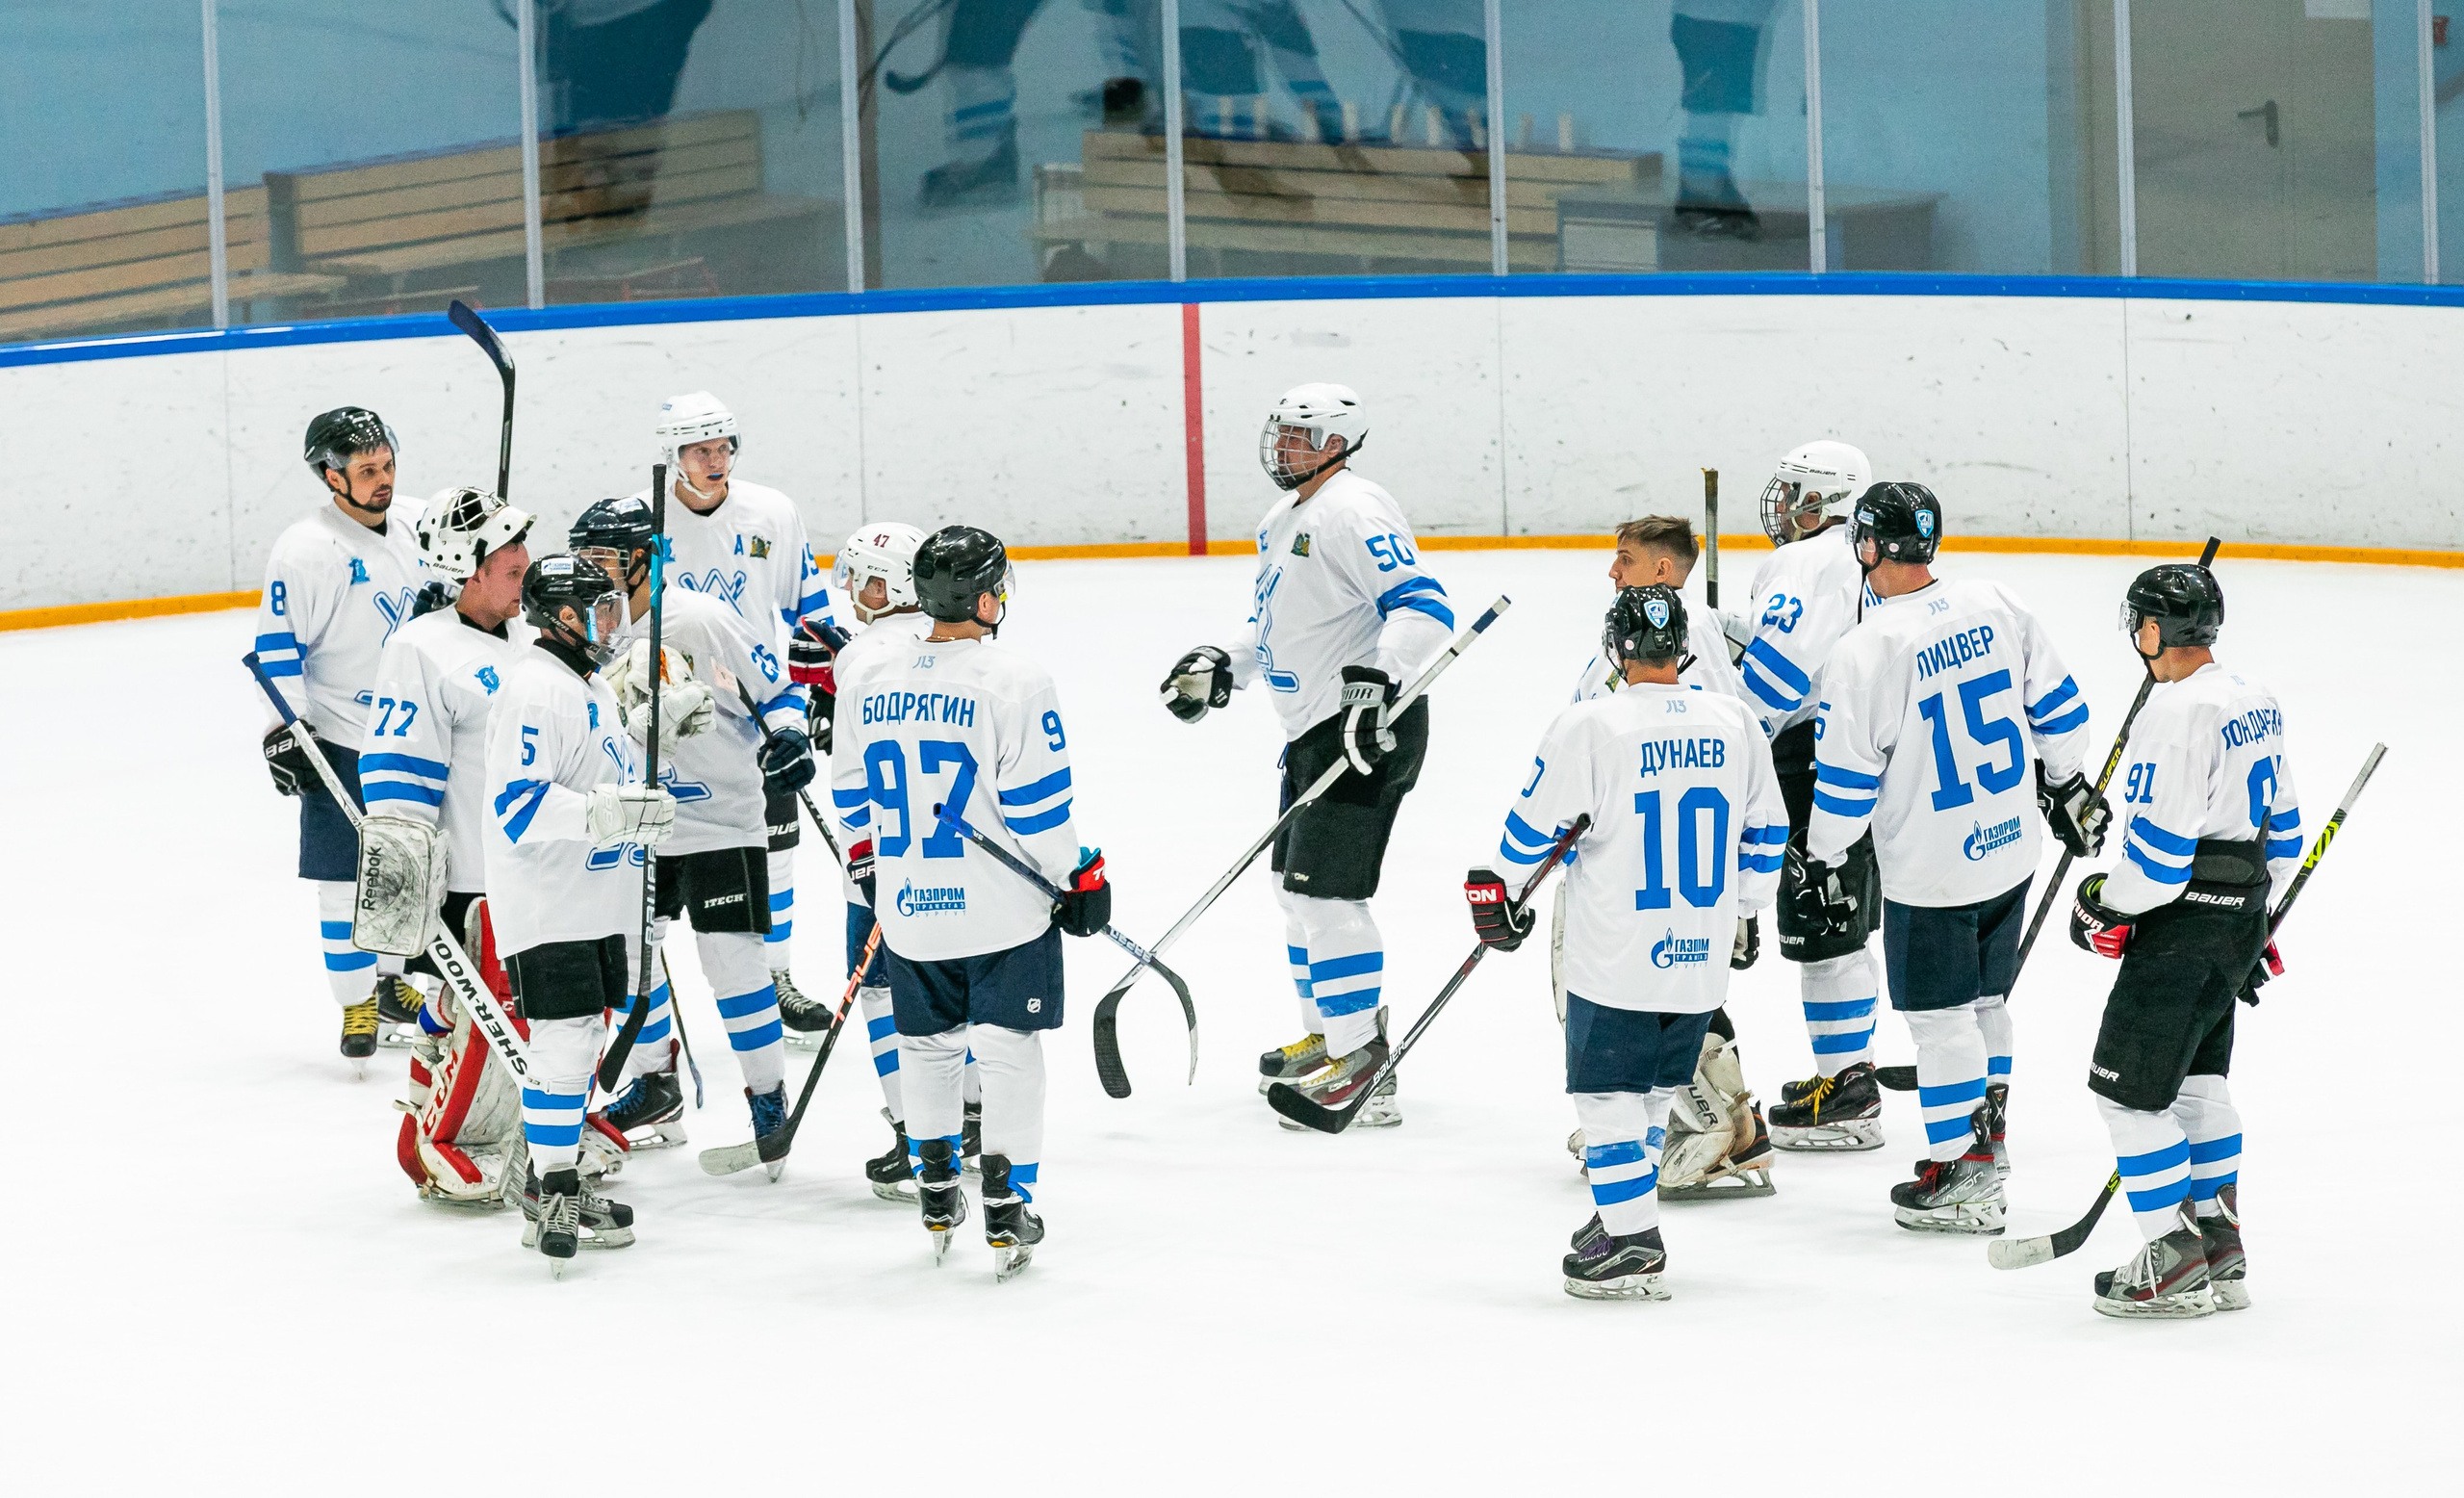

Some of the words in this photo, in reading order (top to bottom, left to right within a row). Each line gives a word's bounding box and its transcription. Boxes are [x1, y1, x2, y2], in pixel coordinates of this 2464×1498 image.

[1809, 468, 1837, 477] BAUER
[873, 533, 890, 548] 47
[1365, 532, 1416, 573] 50
[432, 562, 465, 575] BAUER
[270, 581, 287, 616] 8
[1761, 593, 1804, 634] 23
[1916, 625, 1994, 682] ЛИЦВЕР
[373, 697, 419, 737] 77
[862, 691, 975, 728] БОДРЯГИН
[521, 725, 539, 766] 5
[1640, 737, 1726, 778] ДУНАЕВ
[1917, 668, 2026, 813] 15
[2098, 747, 2122, 792] SUPER
[2124, 762, 2157, 804] 91
[863, 739, 979, 859] 97
[1634, 787, 1730, 911] 10
[1983, 815, 2021, 842] ГАЗПРОМ
[361, 845, 382, 912] Reebok
[914, 887, 965, 902] ГАЗПРОМ
[1466, 889, 1498, 902] ON
[704, 893, 744, 909] ITECH
[915, 902, 965, 911] ТРАНСГАЗ
[2185, 891, 2246, 908] BAUER
[831, 921, 882, 1029] TRUE
[435, 940, 527, 1075] SHER-WOO
[1373, 1040, 1406, 1086] BAUER
